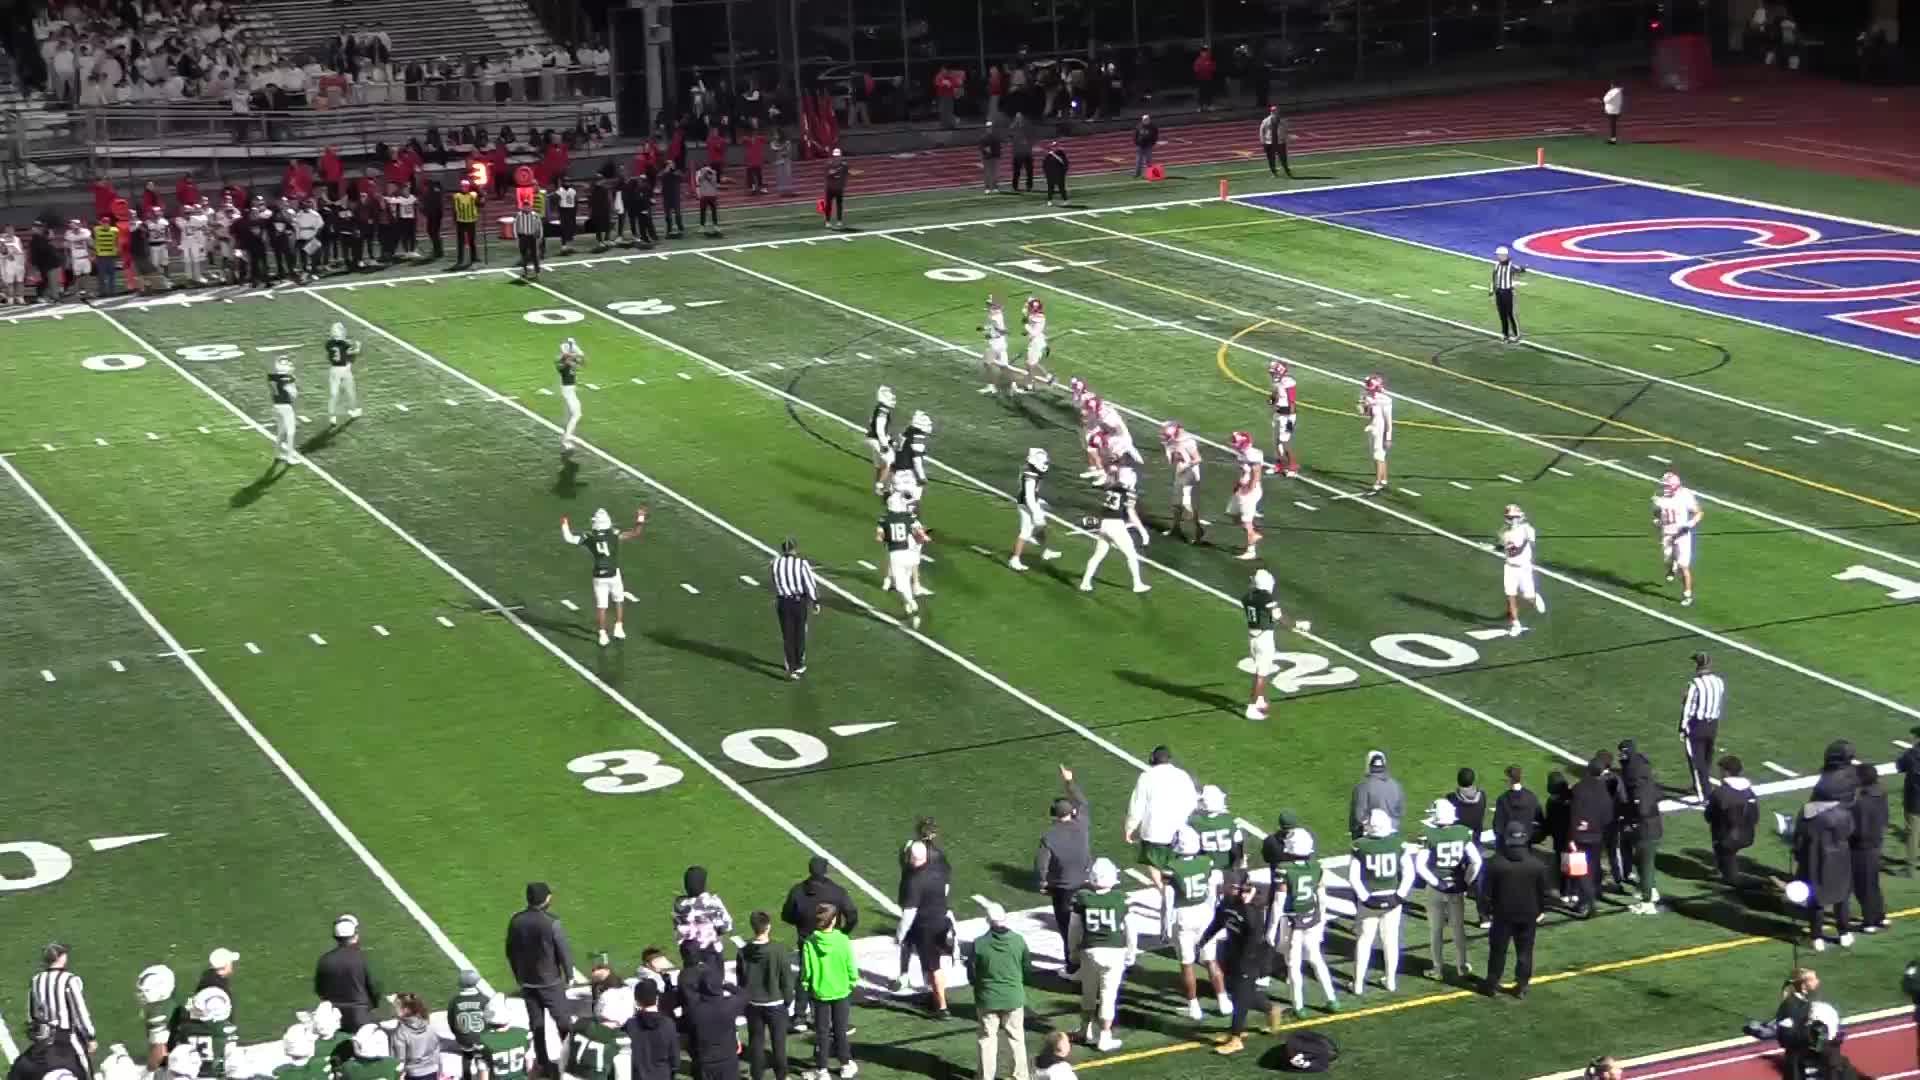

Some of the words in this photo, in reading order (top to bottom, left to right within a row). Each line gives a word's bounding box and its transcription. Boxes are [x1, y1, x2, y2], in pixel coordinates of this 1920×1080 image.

[333, 349, 342, 362] 3
[1662, 507, 1677, 525] 11
[890, 522, 907, 542] 18
[596, 541, 610, 557] 4
[566, 730, 829, 794] 30
[1366, 853, 1397, 878] 40
[1184, 873, 1207, 899] 15
[1297, 875, 1313, 900] 5
[1085, 908, 1117, 932] 54
[573, 1034, 606, 1072] 77
